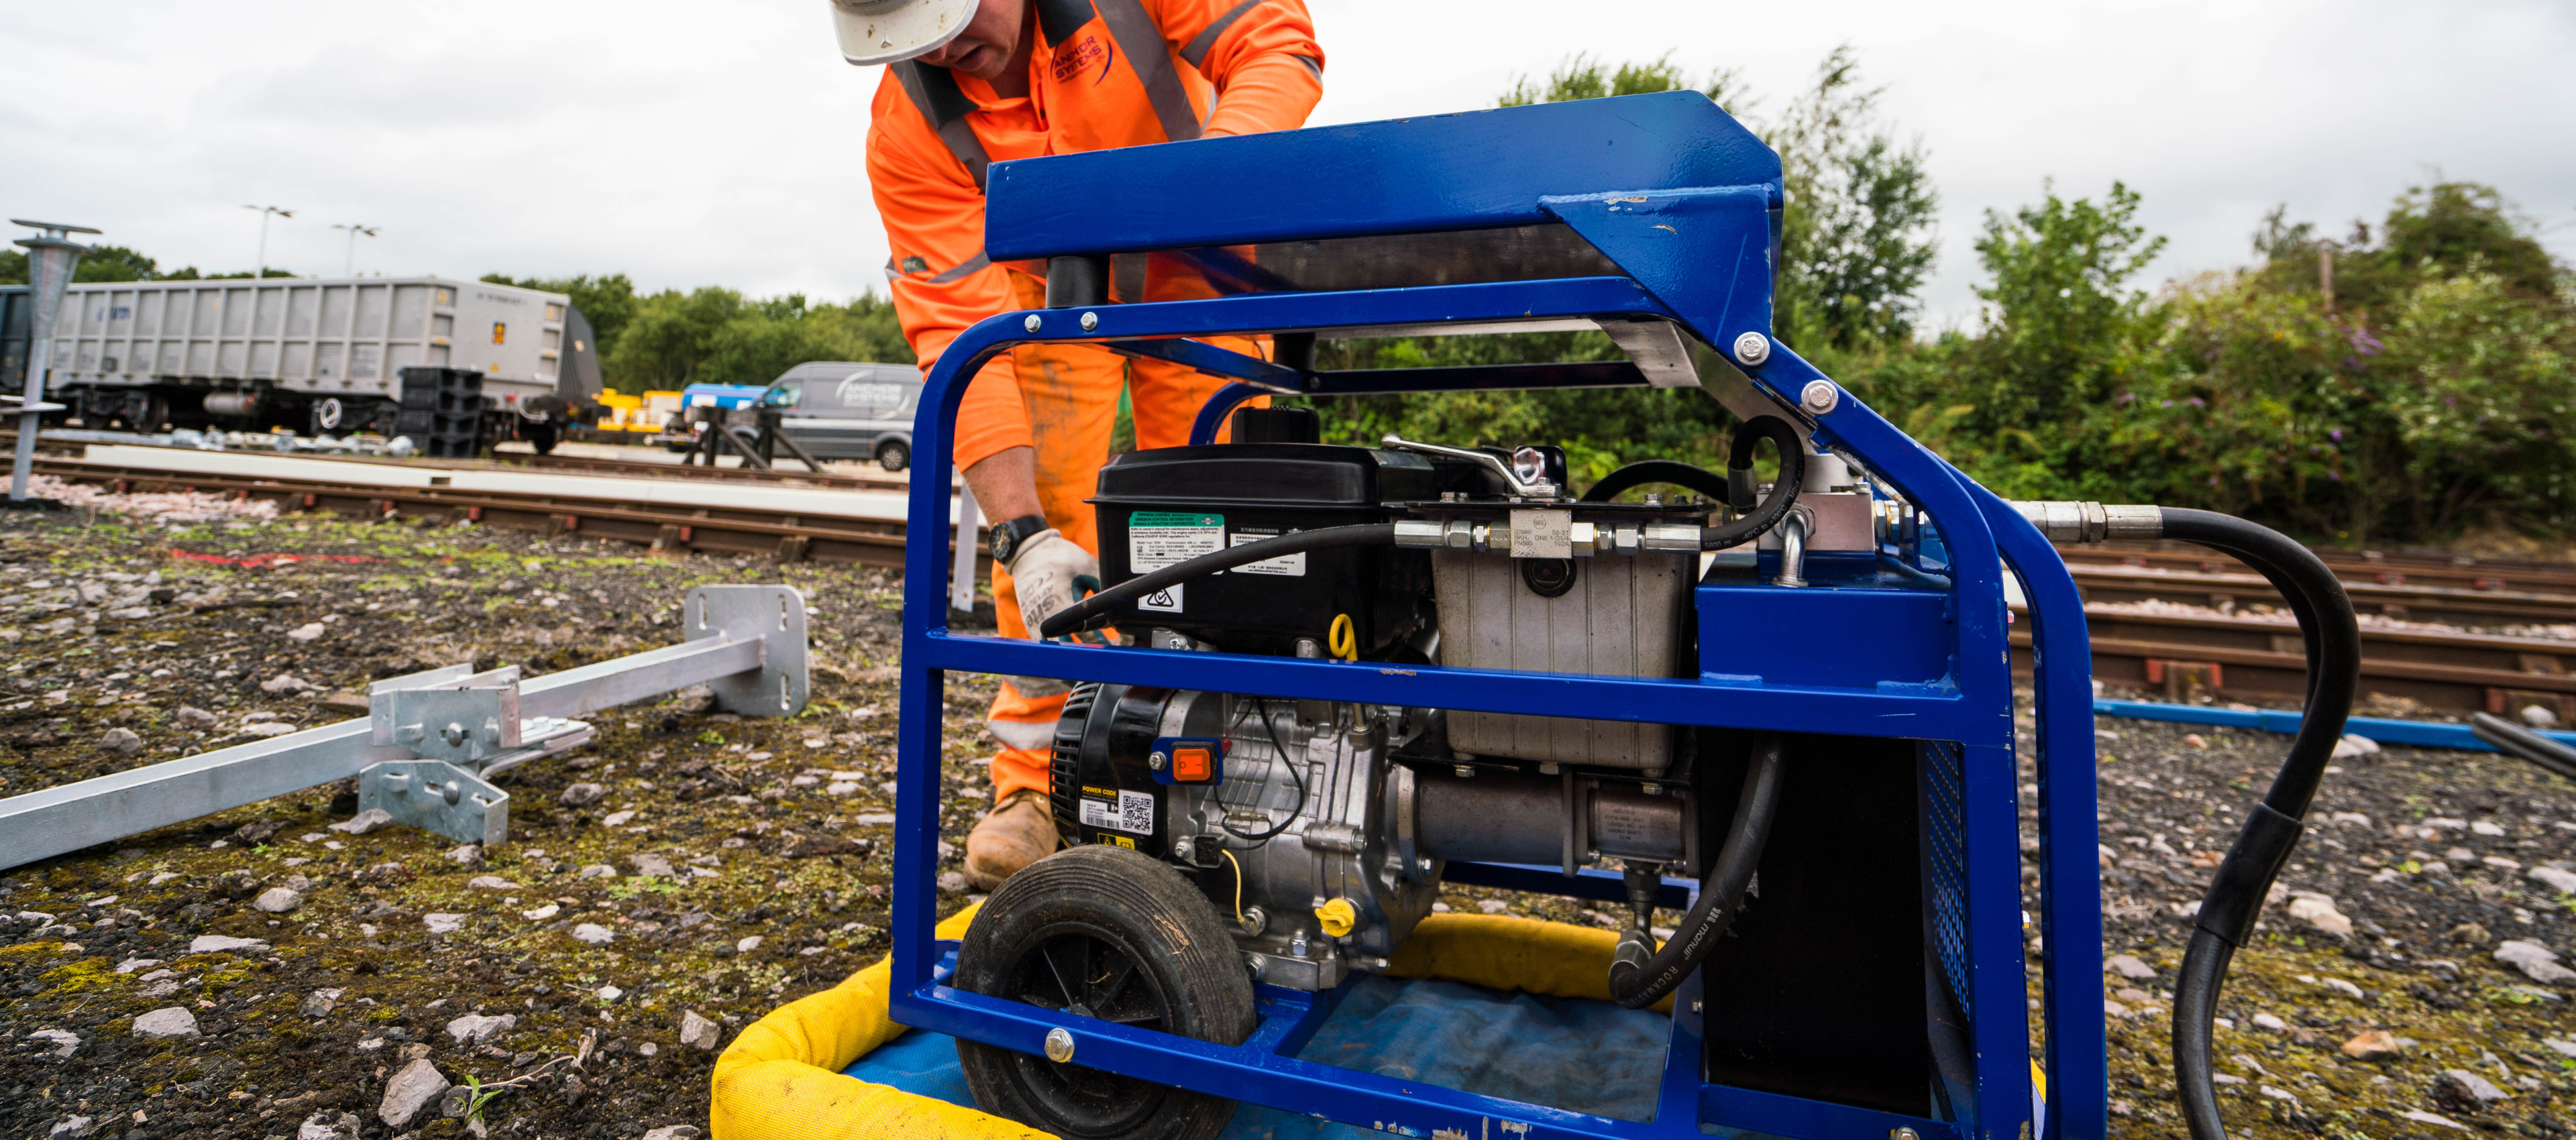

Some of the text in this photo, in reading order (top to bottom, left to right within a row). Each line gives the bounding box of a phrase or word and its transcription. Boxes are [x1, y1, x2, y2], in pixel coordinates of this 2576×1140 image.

[1789, 480, 1801, 499] MSHA
[1082, 785, 1102, 794] POWER
[1102, 789, 1117, 797] CODE
